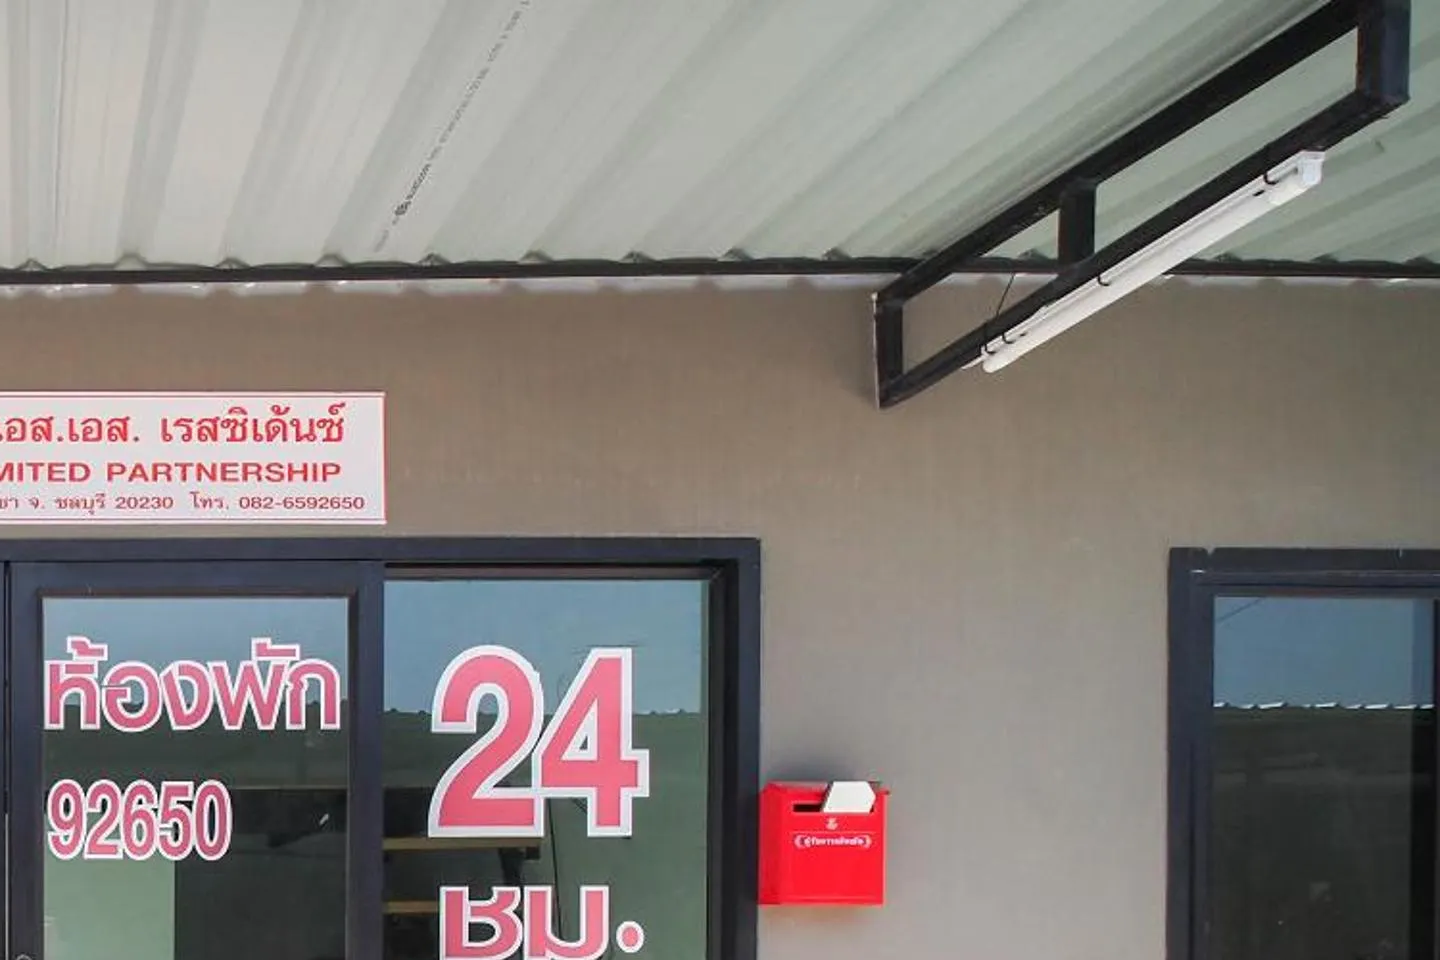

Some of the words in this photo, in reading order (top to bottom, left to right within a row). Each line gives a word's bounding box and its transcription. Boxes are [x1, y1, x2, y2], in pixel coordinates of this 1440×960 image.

[160, 401, 347, 443] เรสซิเด้นซ์
[53, 492, 107, 516] ชลบุรี
[114, 496, 174, 510] 20230
[188, 490, 230, 510] โทร.
[238, 495, 366, 510] 082-6592650
[106, 461, 342, 483] PARTNERSHIP
[44, 636, 341, 732] ห้องพัก
[428, 645, 650, 837] 24
[47, 779, 231, 861] 92650
